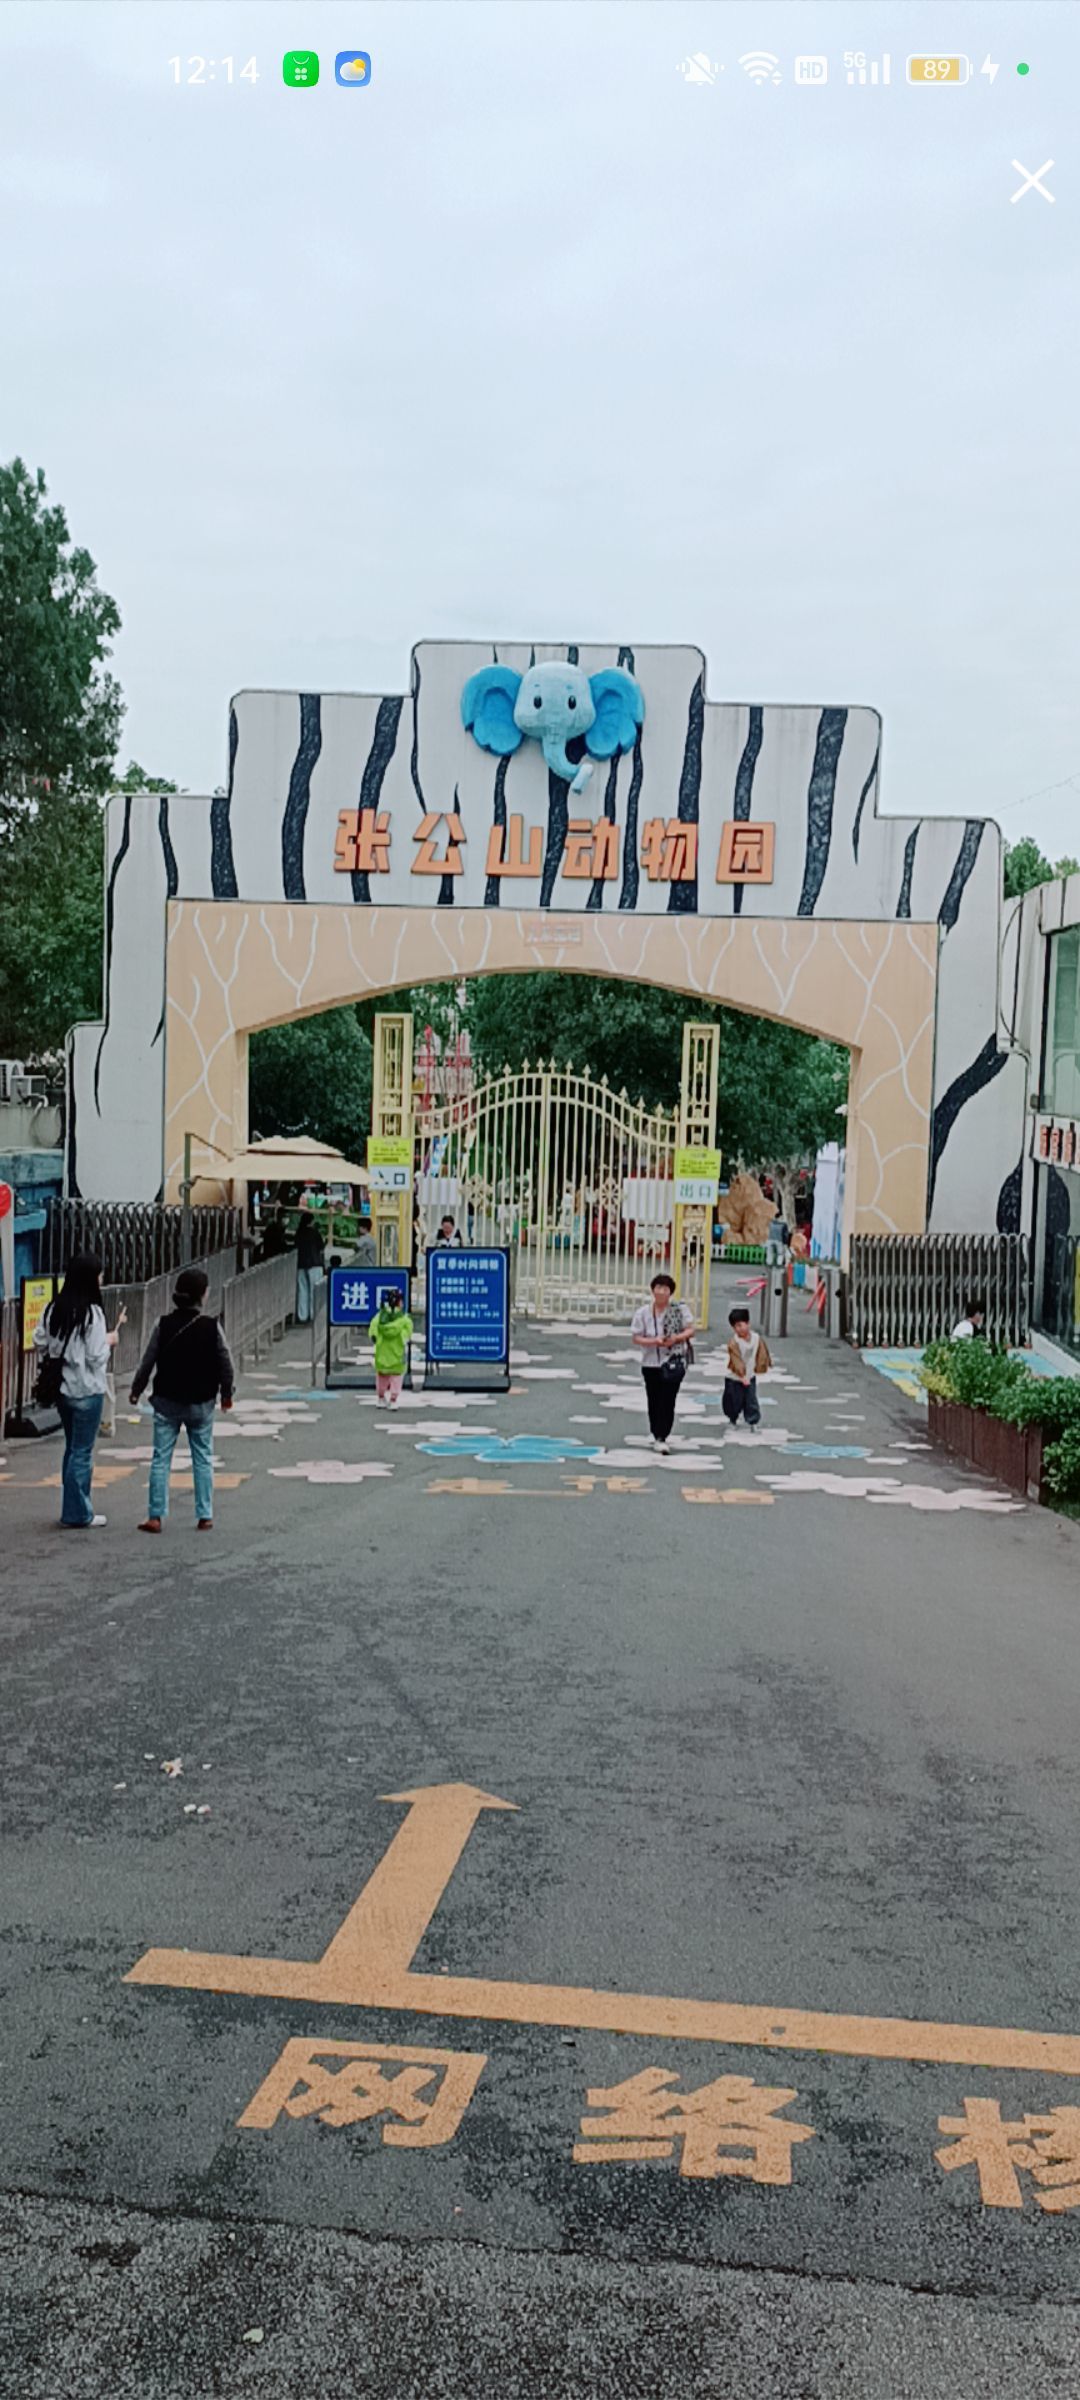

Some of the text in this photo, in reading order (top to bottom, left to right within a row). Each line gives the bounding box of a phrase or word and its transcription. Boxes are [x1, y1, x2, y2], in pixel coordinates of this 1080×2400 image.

[333, 808, 777, 885] 张公山动物园
